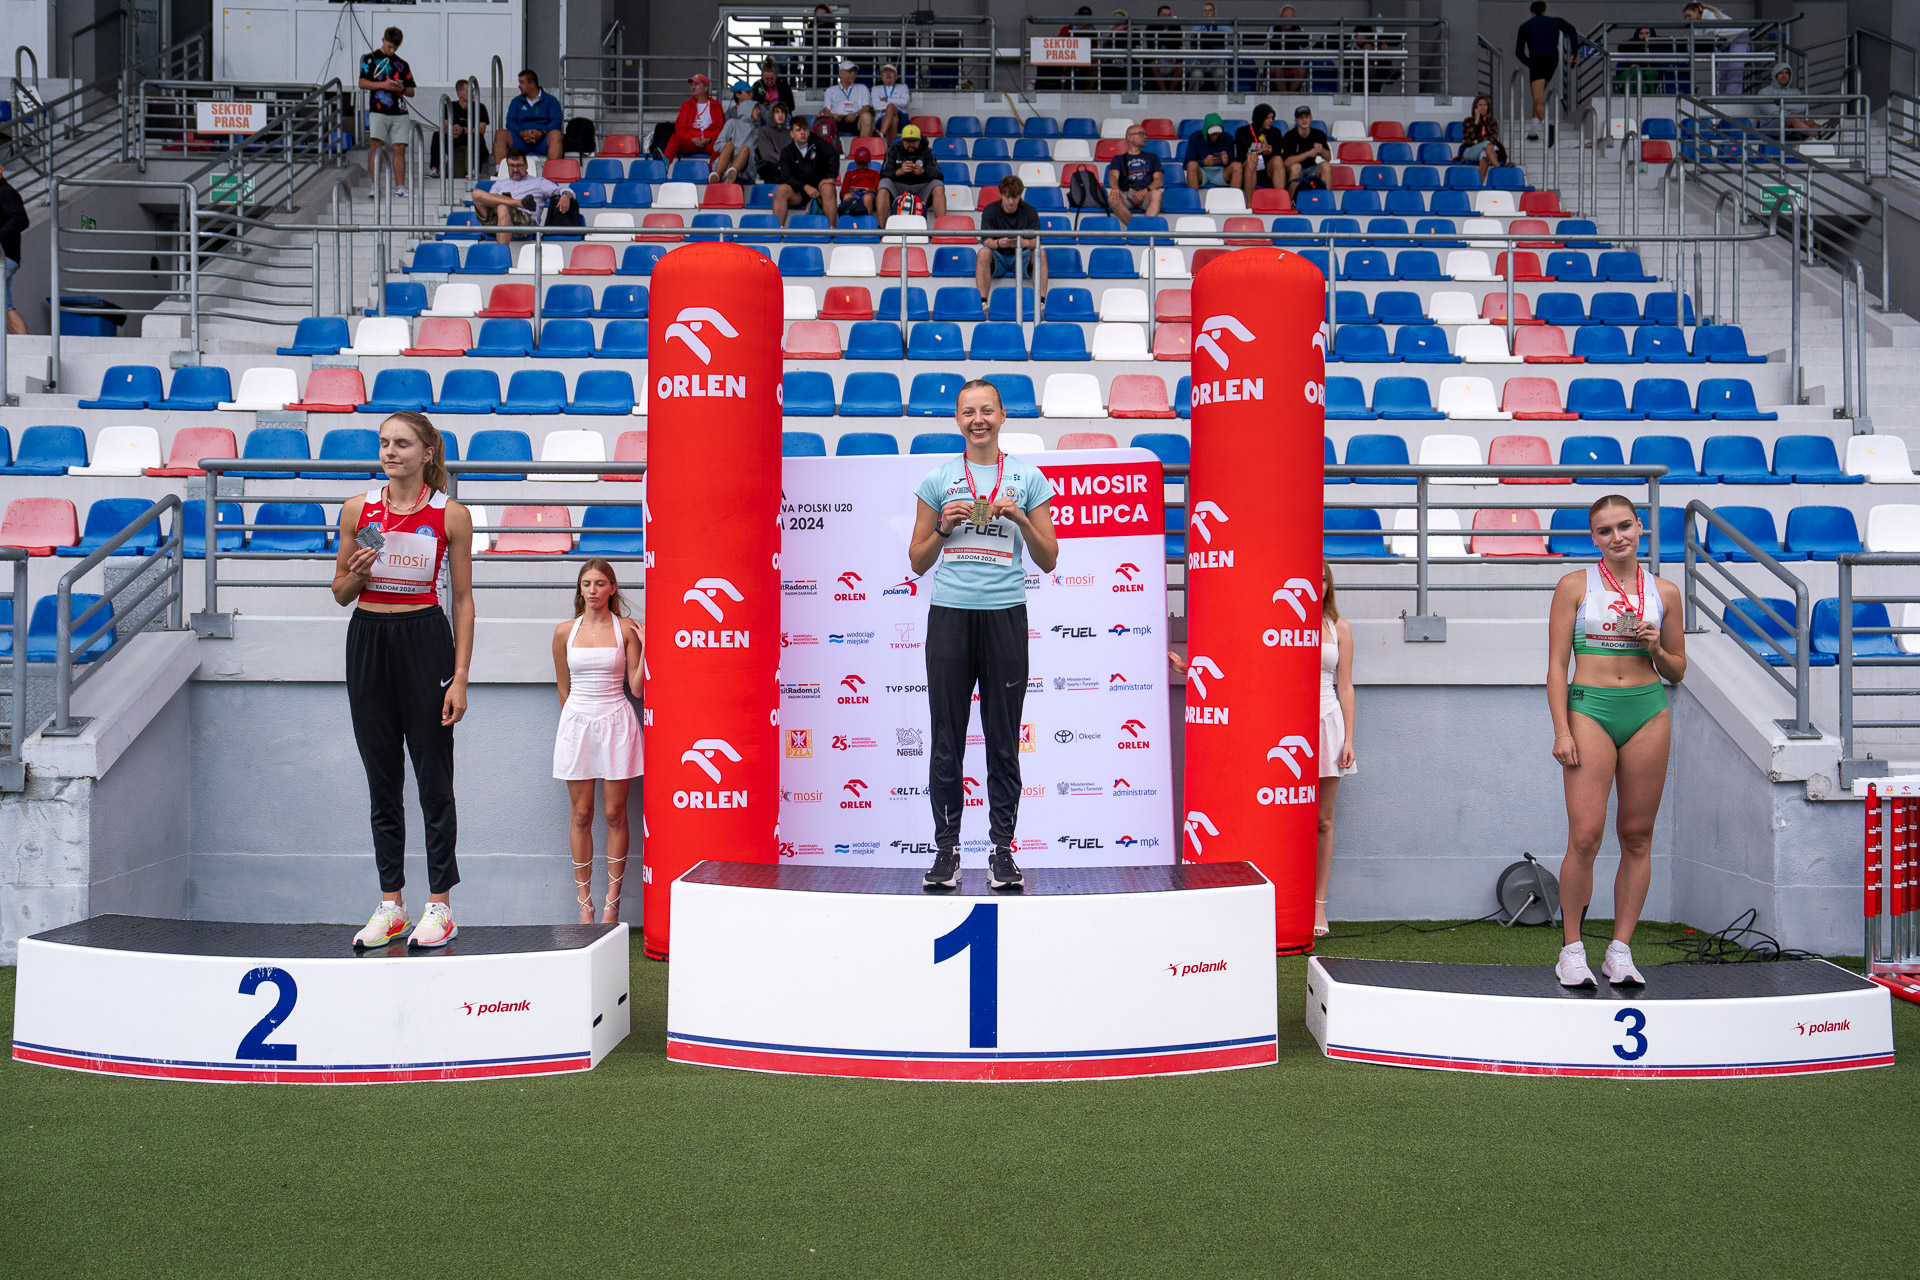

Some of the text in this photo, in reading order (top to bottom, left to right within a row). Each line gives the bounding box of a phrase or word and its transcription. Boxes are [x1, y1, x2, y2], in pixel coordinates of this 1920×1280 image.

[1043, 38, 1079, 49] SEKTOR
[1046, 50, 1076, 60] PRASA
[211, 103, 253, 115] SEKTOR
[214, 116, 250, 128] PRASA
[657, 374, 746, 399] ORLEN
[1191, 378, 1264, 408] ORLEN
[1071, 474, 1148, 496] MOSIR
[798, 503, 831, 513] POLSKI
[834, 503, 853, 513] U20
[1080, 503, 1149, 525] LIPCA
[790, 517, 825, 530] 2024
[964, 521, 1009, 539] FUEL
[388, 553, 430, 568] mosir
[1188, 549, 1235, 571] ORLEN
[1066, 574, 1095, 585] mosir
[780, 582, 817, 592] itRadom.pl
[883, 587, 910, 596] polanik
[1112, 584, 1144, 592] ORLEN
[834, 593, 866, 602] ORLEN
[1063, 627, 1097, 638] FUEL
[1133, 625, 1152, 636] mpk
[674, 629, 750, 648] ORLEN
[1262, 628, 1320, 647] ORLEN
[780, 687, 820, 695] sitRadom.pl
[886, 685, 903, 693] TVP
[1109, 683, 1153, 691] administrator
[837, 696, 869, 704] ORLEN
[1185, 706, 1229, 725] ORLEN
[1079, 733, 1101, 741] Okęcie
[1118, 741, 1150, 750] ORLEN
[787, 748, 812, 757] PZLA
[897, 748, 923, 757] Nestlé
[794, 790, 823, 801] mosir
[897, 787, 920, 795] RLTL
[1112, 788, 1157, 797] administrator
[1256, 785, 1316, 805] ORLEN
[672, 789, 748, 809] ORLEN
[840, 800, 872, 809] ORLEN
[1069, 838, 1104, 849] FUEL
[1140, 837, 1160, 848] mpk
[934, 903, 998, 1048] 1
[236, 967, 298, 1061] 2
[1612, 1007, 1648, 1060] 3
